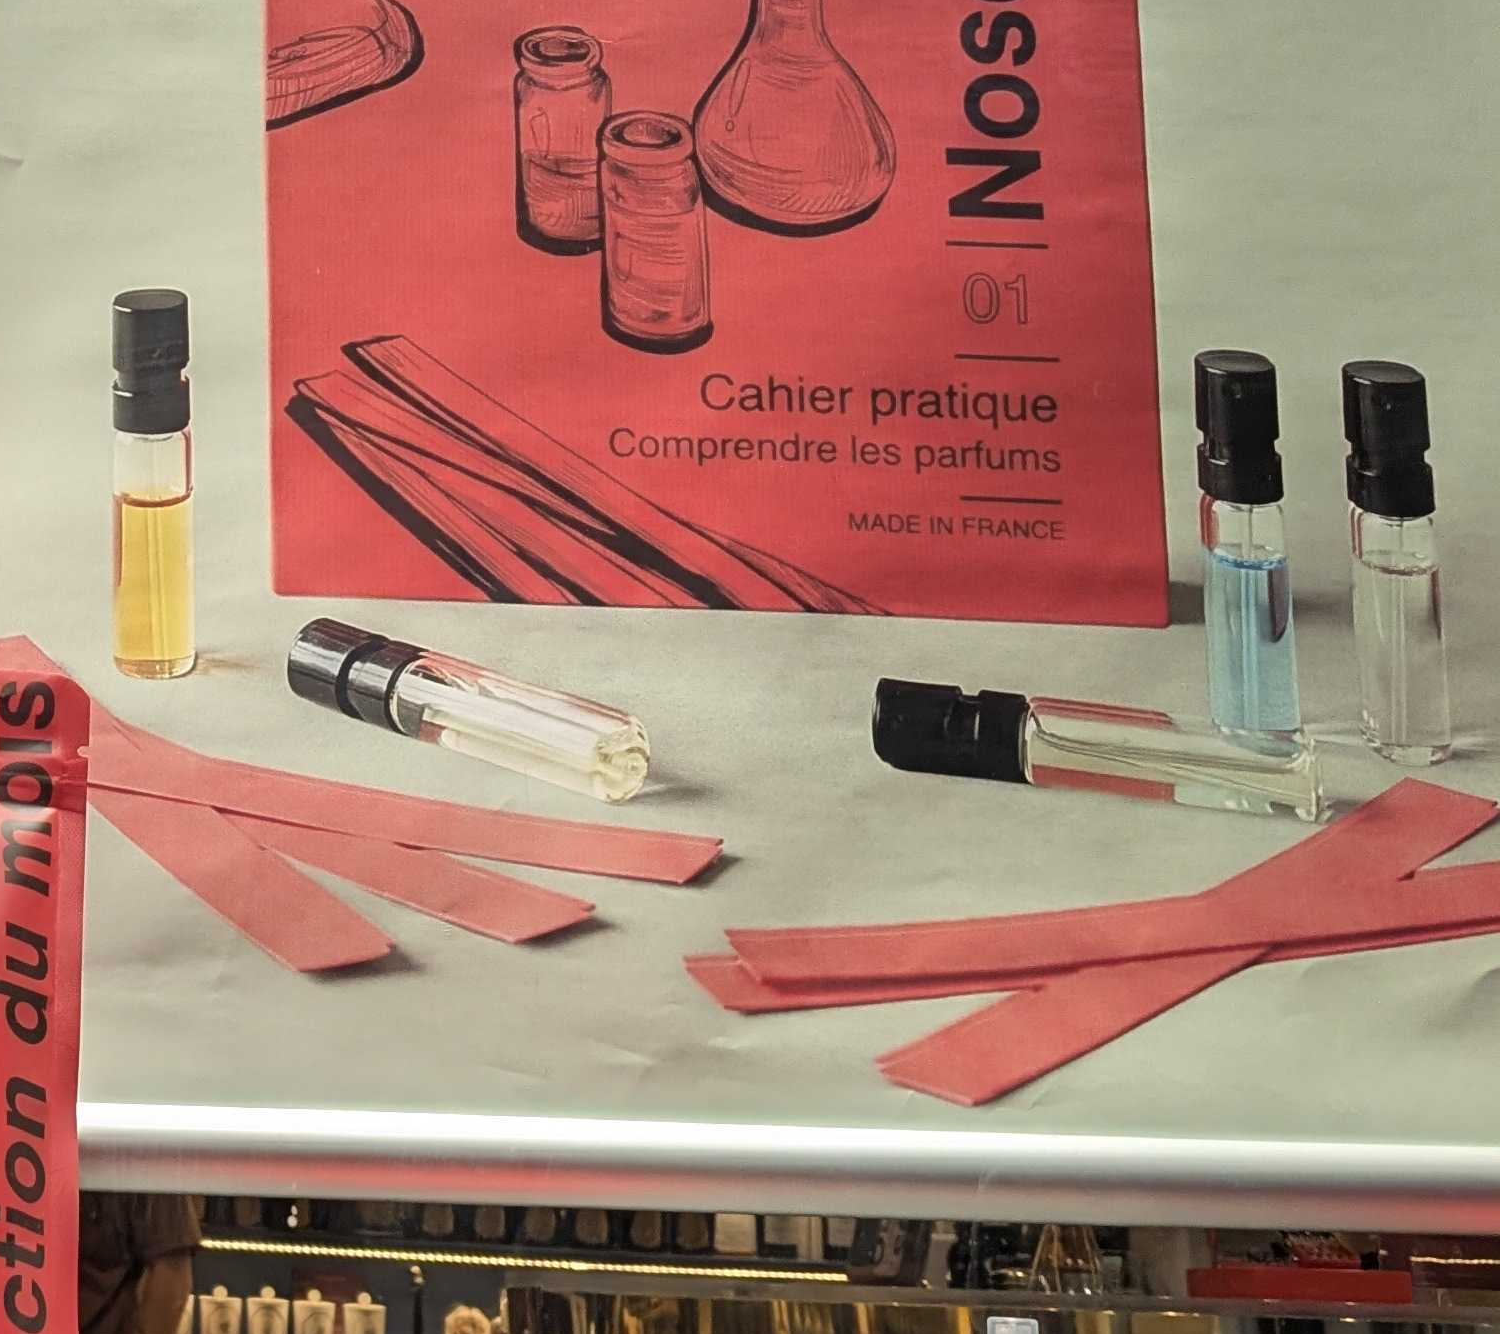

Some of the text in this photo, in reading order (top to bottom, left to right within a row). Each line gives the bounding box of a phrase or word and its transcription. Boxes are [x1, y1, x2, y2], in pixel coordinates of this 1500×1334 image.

[962, 272, 1032, 327] 01
[700, 373, 1059, 429] Cahier pratique
[608, 428, 1063, 474] Comprendre les parfums
[848, 512, 1067, 541] MADE IN FRANCE
